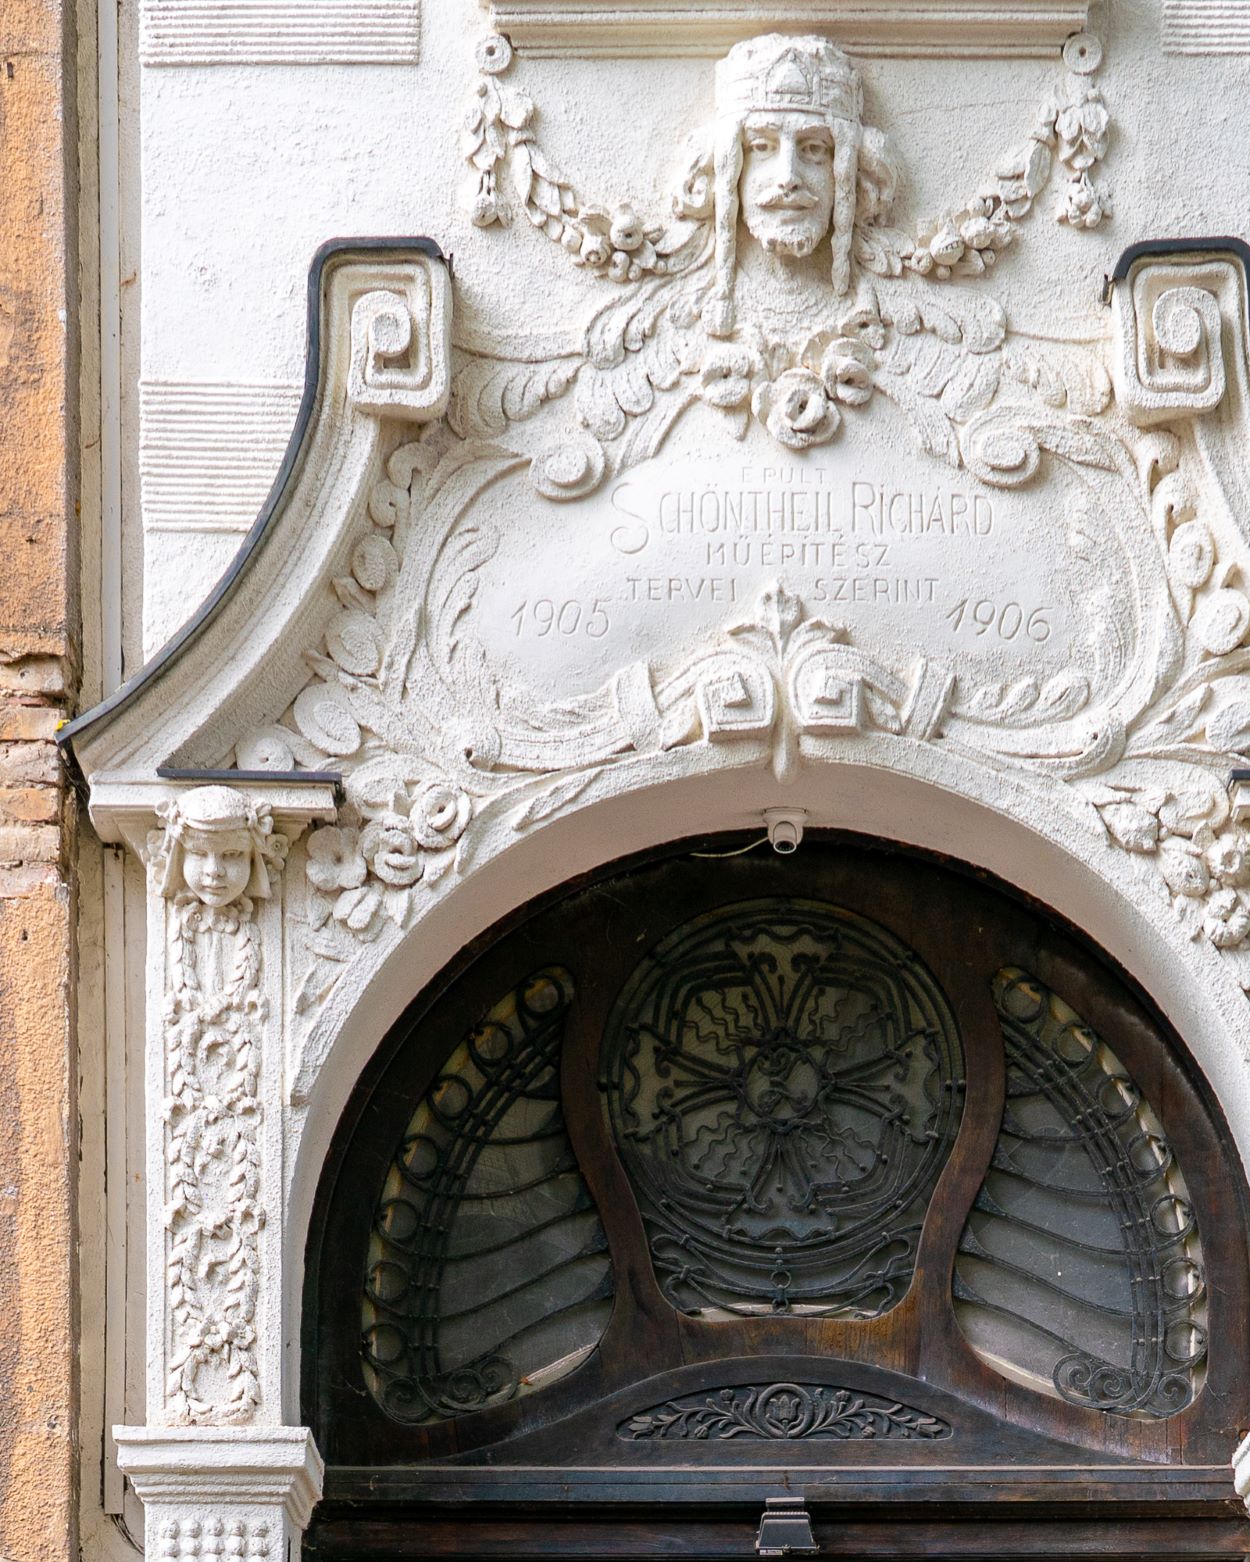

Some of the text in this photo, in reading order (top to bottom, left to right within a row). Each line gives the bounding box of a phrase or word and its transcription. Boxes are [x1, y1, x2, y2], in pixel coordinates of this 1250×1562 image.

[609, 481, 995, 555] SCHÖNTHEIL RICHÁRD
[626, 576, 941, 603] TERVEI SZERINT
[509, 598, 611, 639] 1905
[944, 599, 1056, 644] 1906
